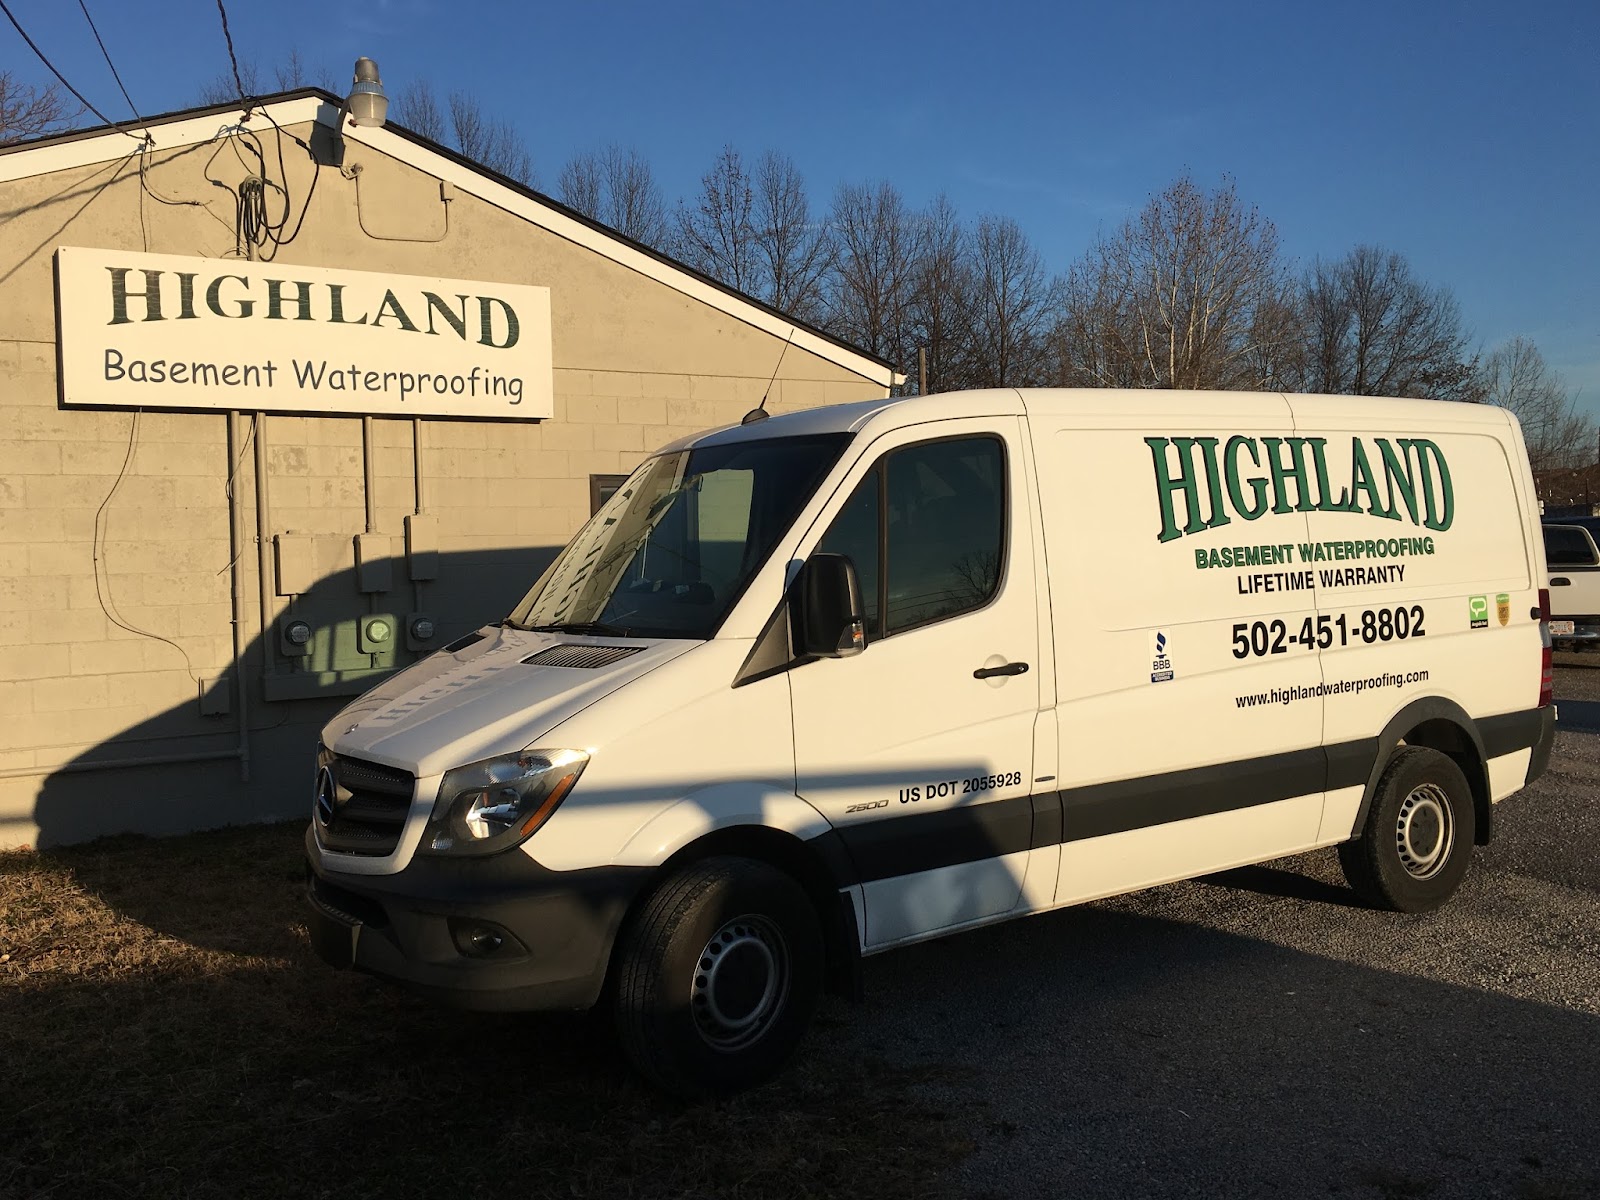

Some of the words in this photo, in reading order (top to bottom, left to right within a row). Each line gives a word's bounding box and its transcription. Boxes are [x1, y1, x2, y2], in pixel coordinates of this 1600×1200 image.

[104, 266, 521, 349] HIGHLAND
[104, 348, 278, 388] Basement
[292, 359, 524, 405] Waterproofing
[1143, 434, 1455, 544] HIGHLAND
[1194, 543, 1294, 570] BASEMENT
[1297, 536, 1435, 563] WATERPROOFING
[1237, 570, 1315, 595] LIFETIME
[1319, 564, 1406, 588] WARRANTY
[1232, 605, 1426, 660] 502-451-8802
[1152, 659, 1171, 671] BBB
[1235, 668, 1430, 709] www.highlandwaterproofing.com
[899, 787, 921, 804] US
[926, 781, 959, 800] DOT
[962, 771, 1022, 794] 2055928
[845, 799, 890, 814] 2500
